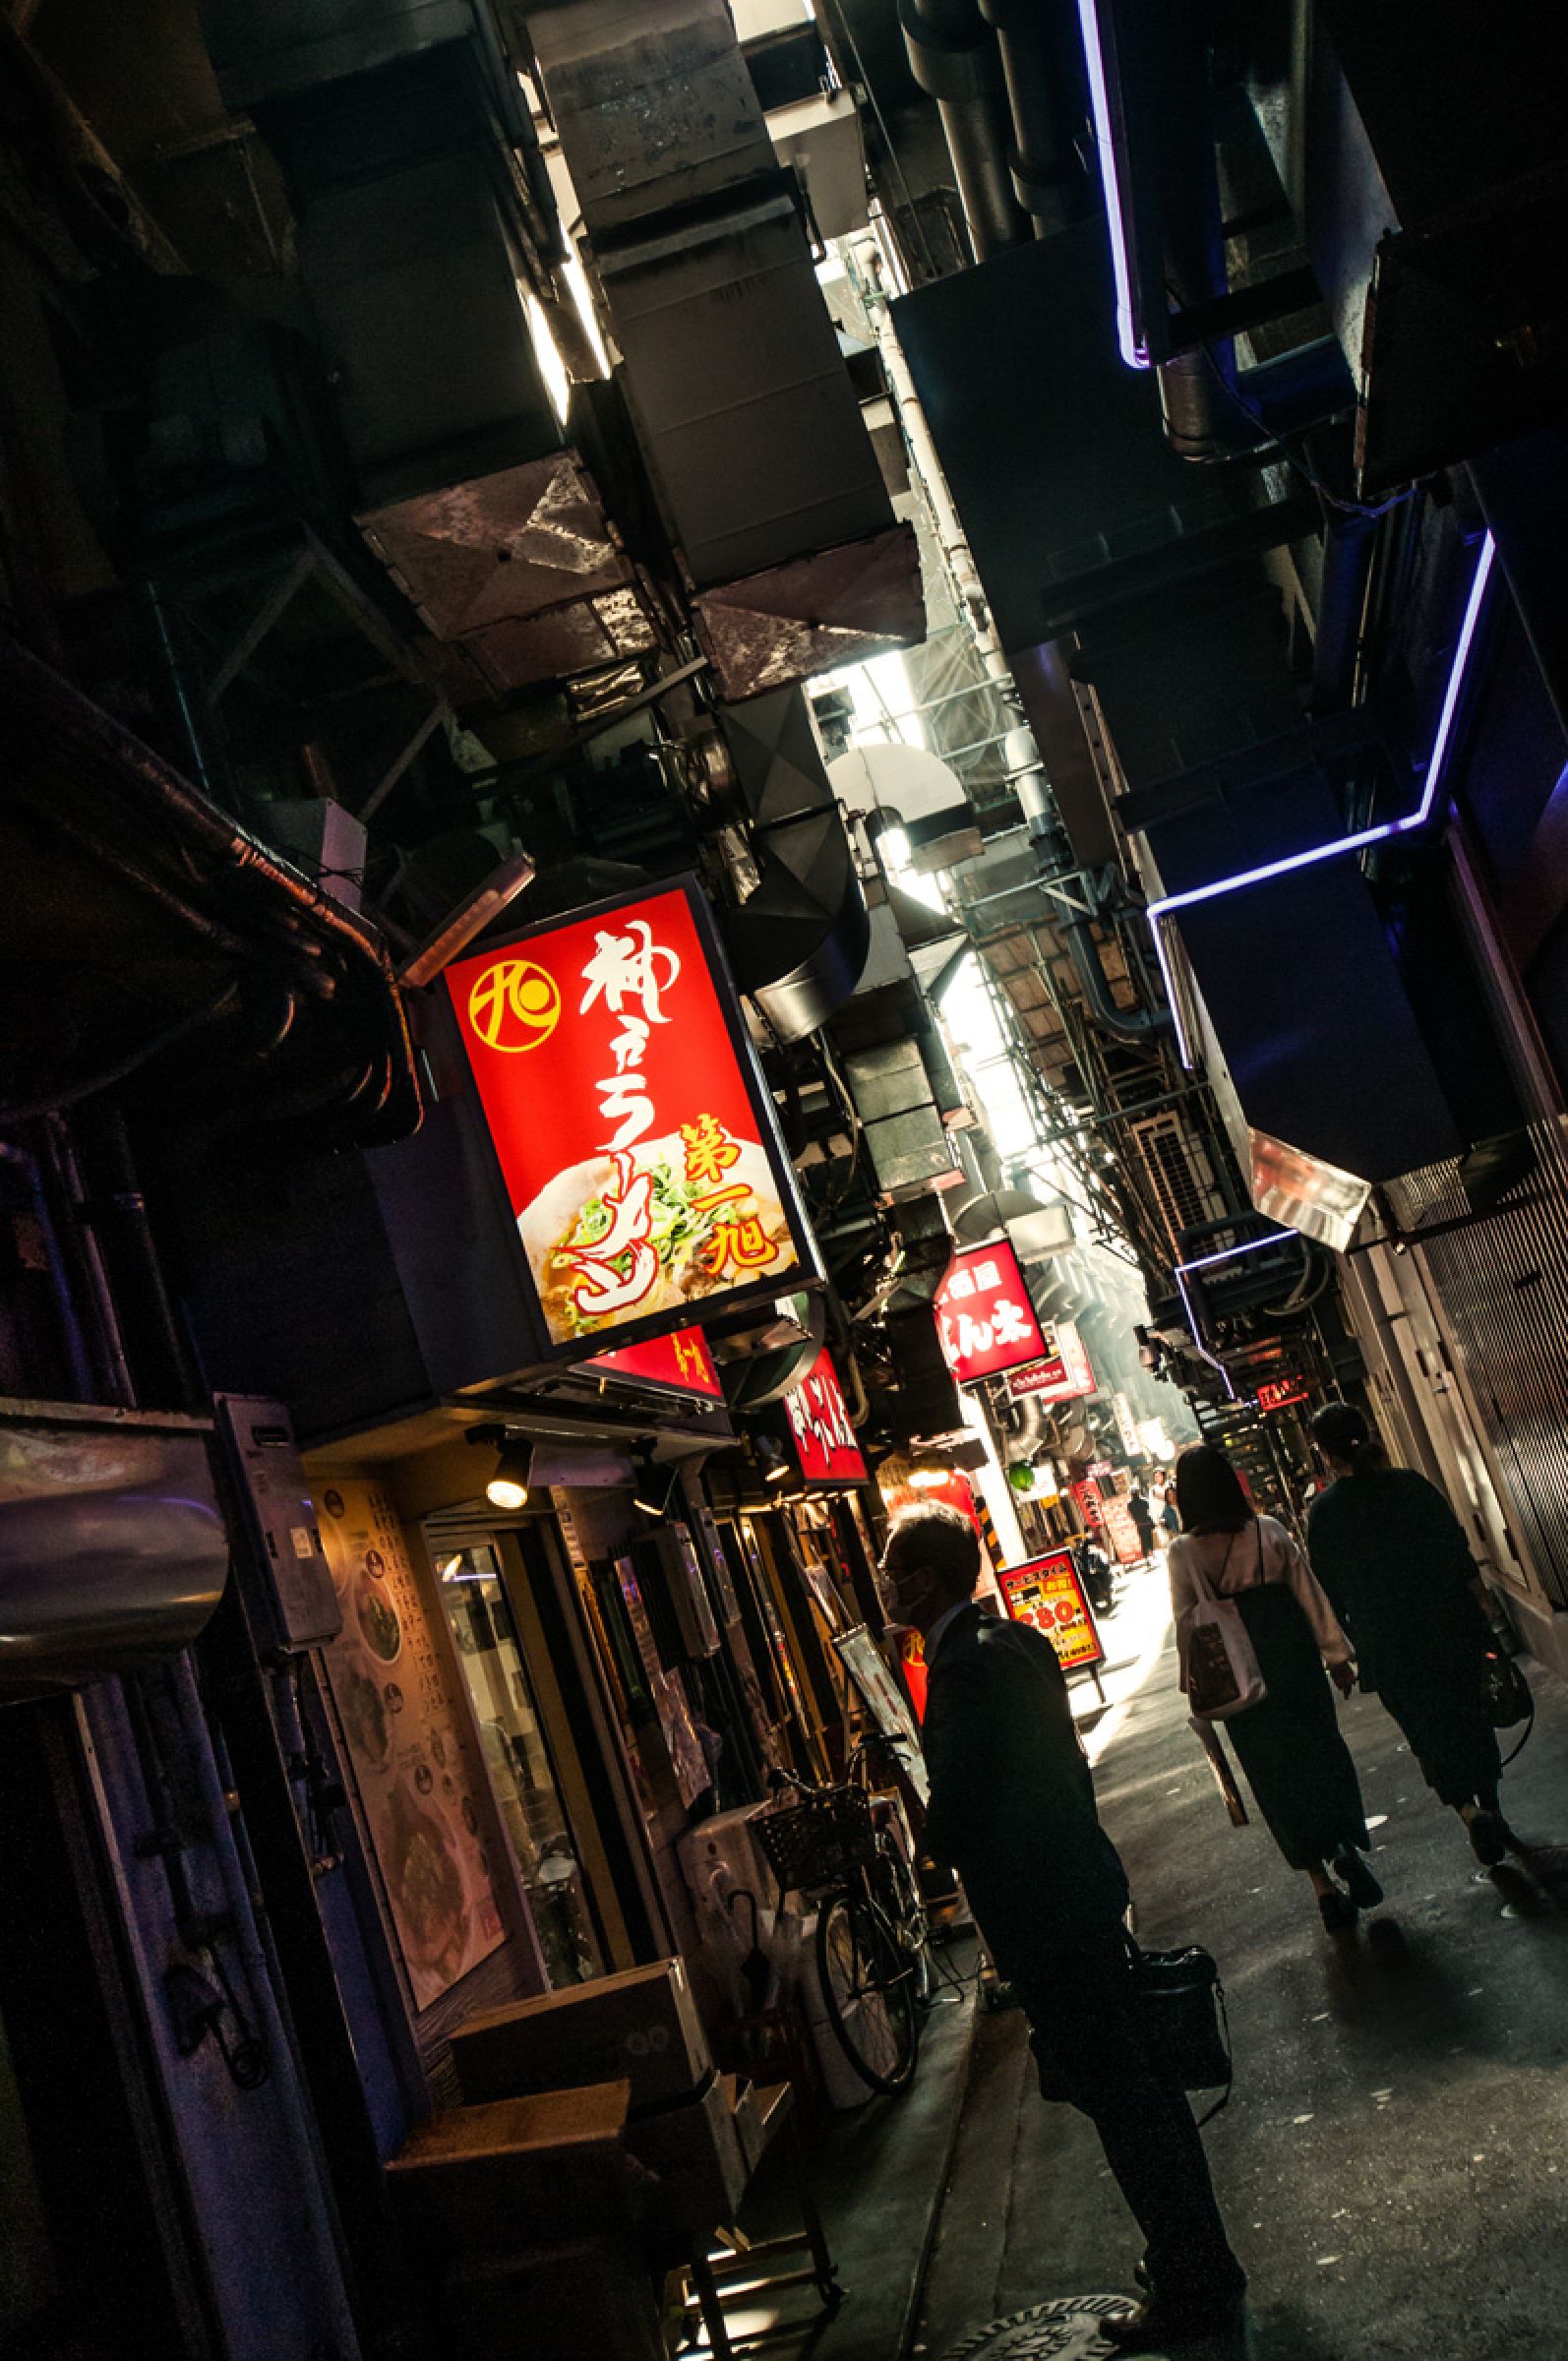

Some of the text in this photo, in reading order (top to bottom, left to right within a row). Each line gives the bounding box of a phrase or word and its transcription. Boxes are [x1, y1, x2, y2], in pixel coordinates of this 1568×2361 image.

[558, 920, 681, 1315] 神戸ラーメン
[679, 1113, 781, 1277] 第一旭
